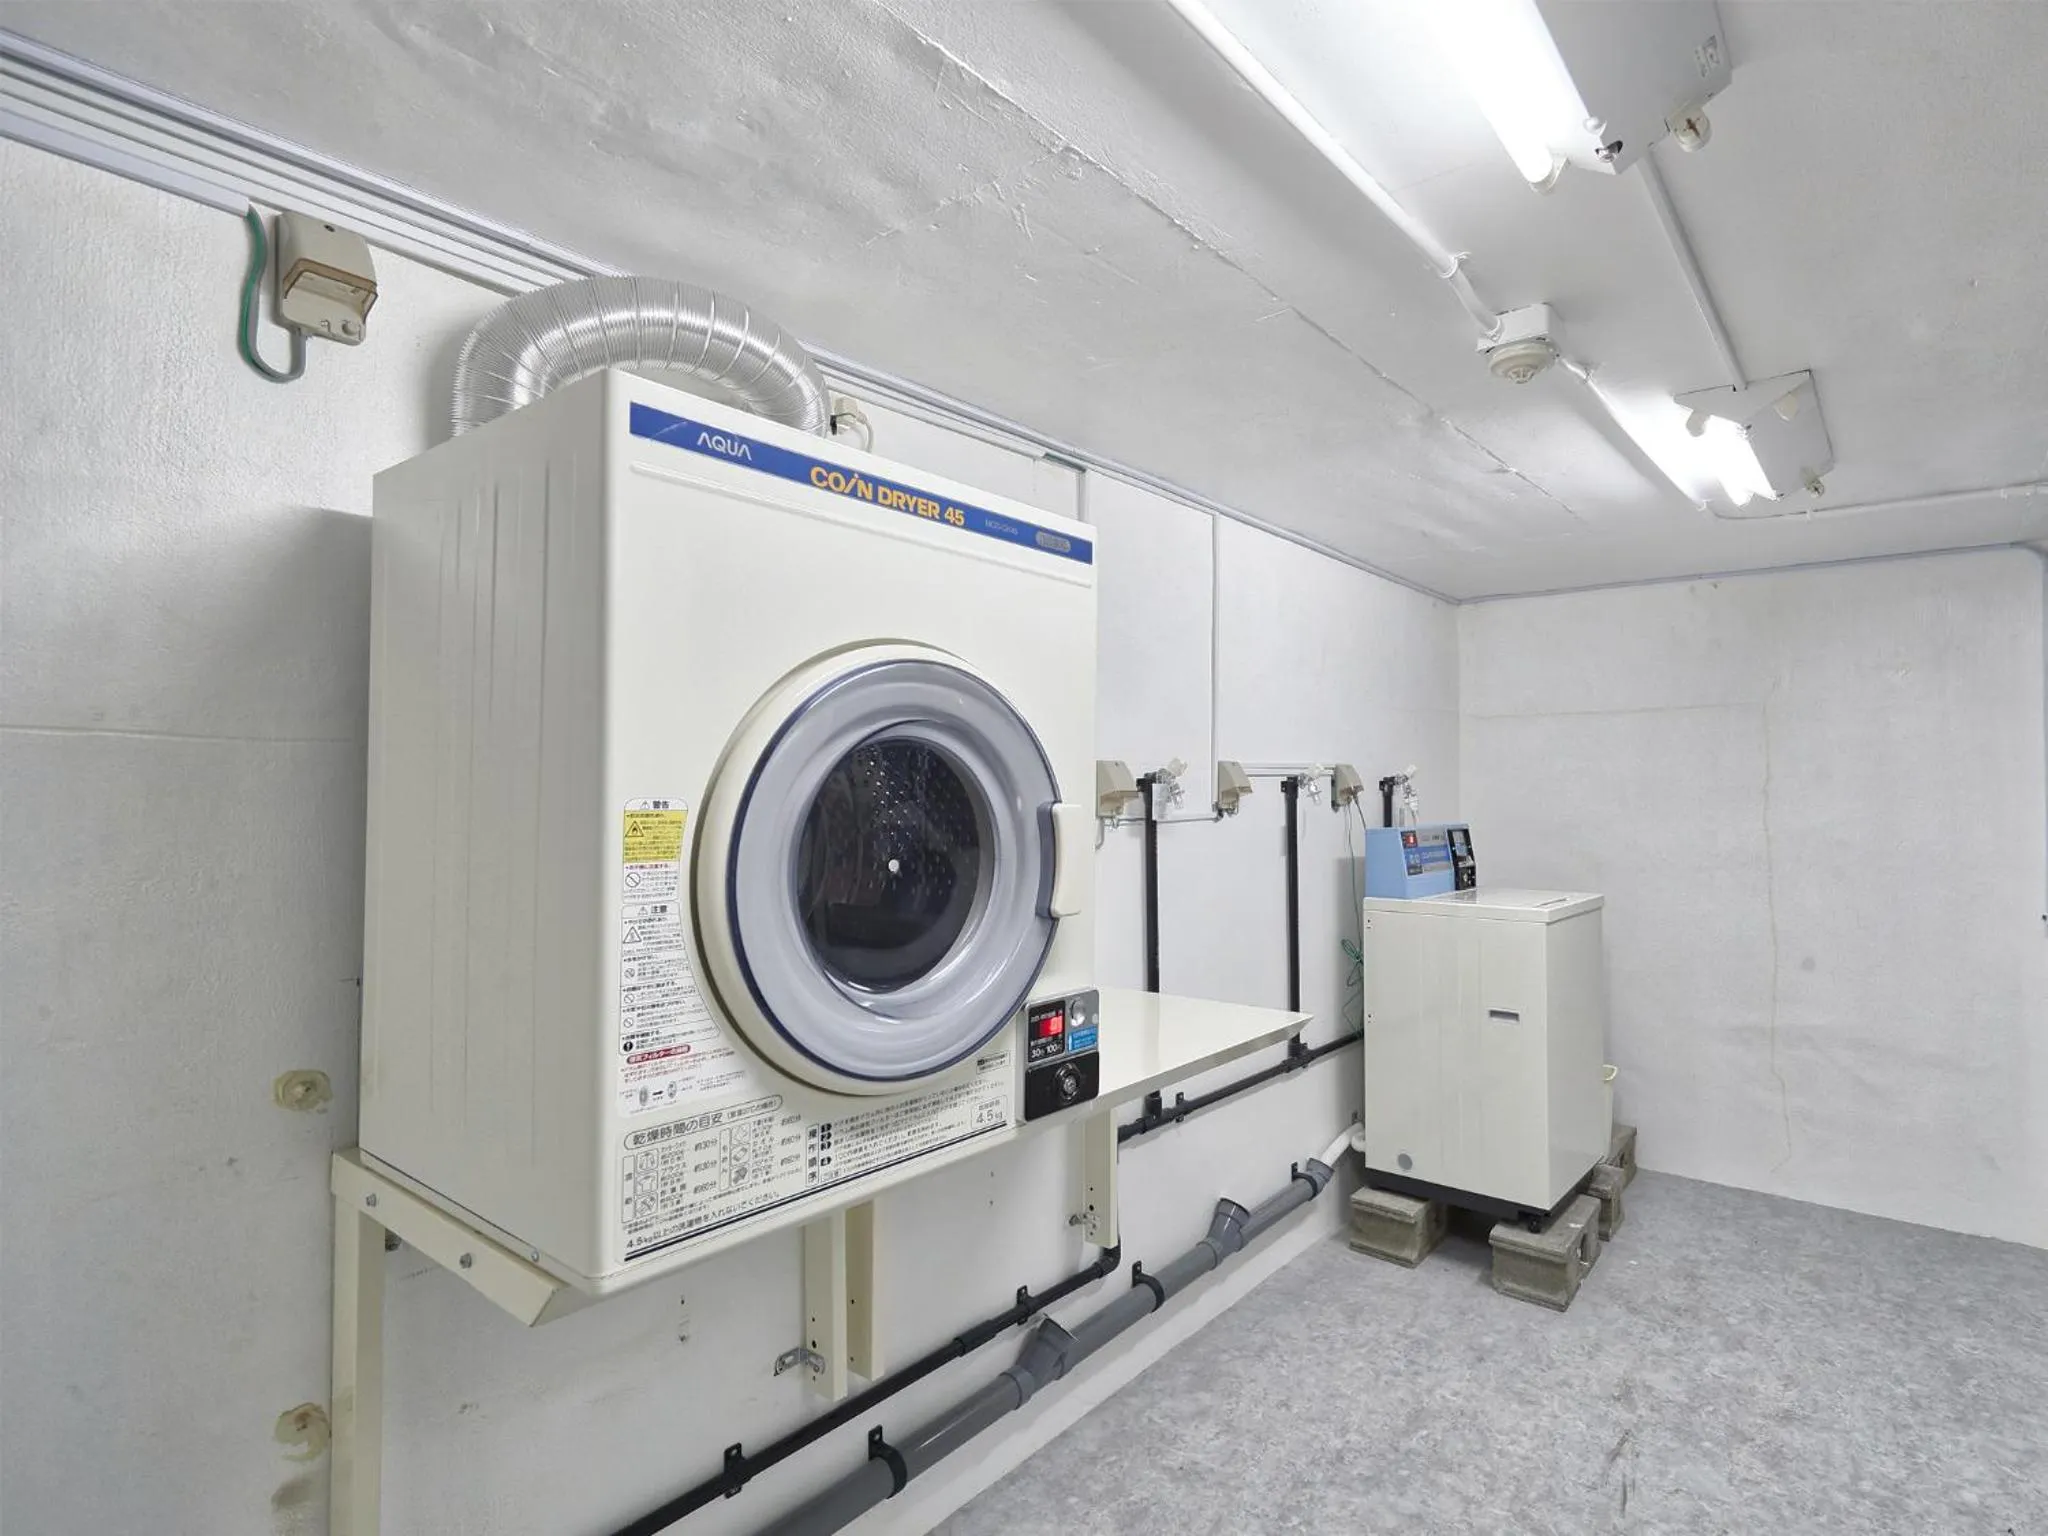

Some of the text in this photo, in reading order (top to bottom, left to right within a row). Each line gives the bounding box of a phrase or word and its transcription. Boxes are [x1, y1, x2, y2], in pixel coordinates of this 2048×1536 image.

[697, 432, 752, 461] AQUA
[810, 465, 965, 526] COIN DRYER 45
[650, 904, 667, 914] 注意
[632, 1112, 723, 1146] 乾燥時間の目安
